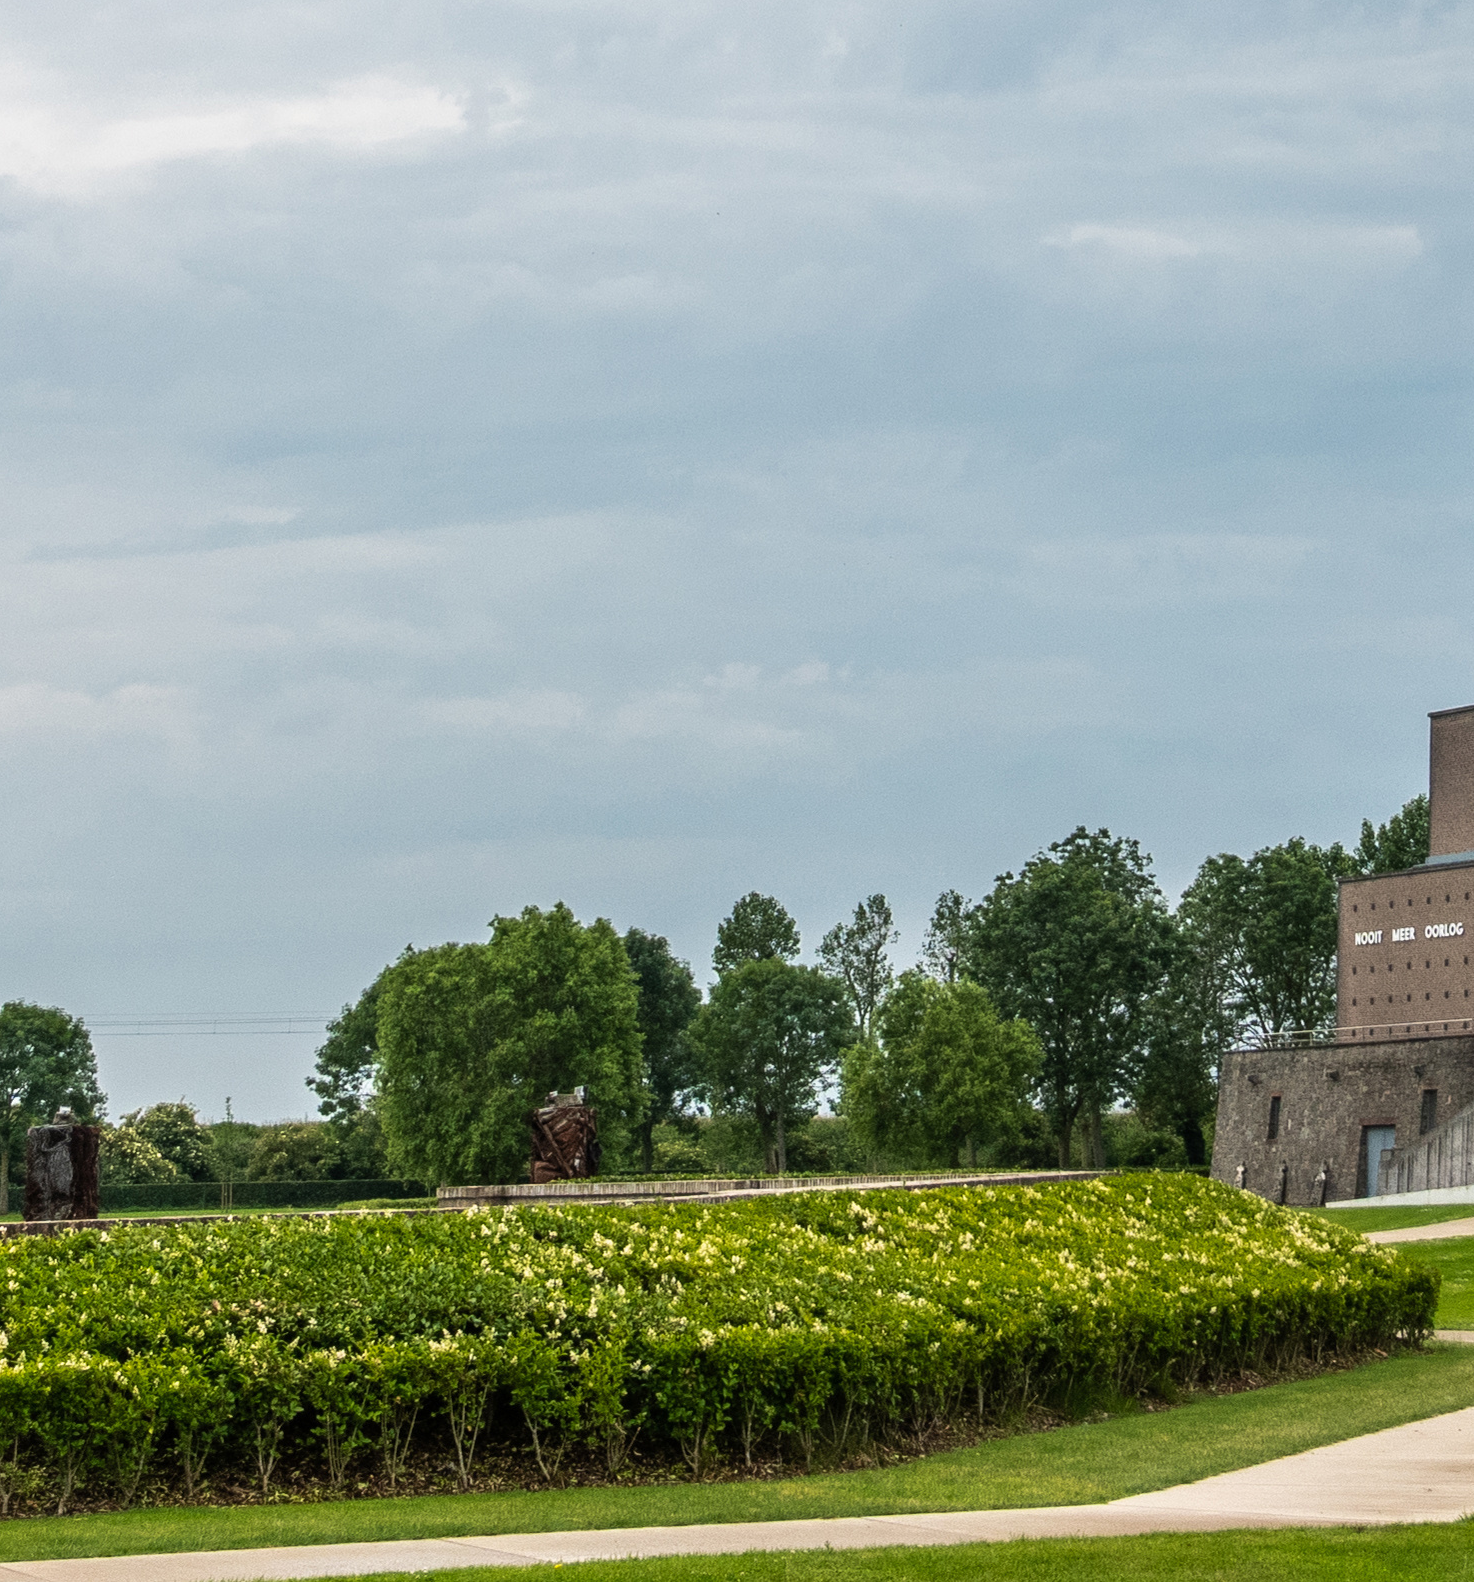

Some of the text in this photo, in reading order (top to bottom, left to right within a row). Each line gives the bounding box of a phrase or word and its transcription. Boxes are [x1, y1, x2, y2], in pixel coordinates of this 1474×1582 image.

[1354, 922, 1464, 946] NOOIT MEER OORLOG
